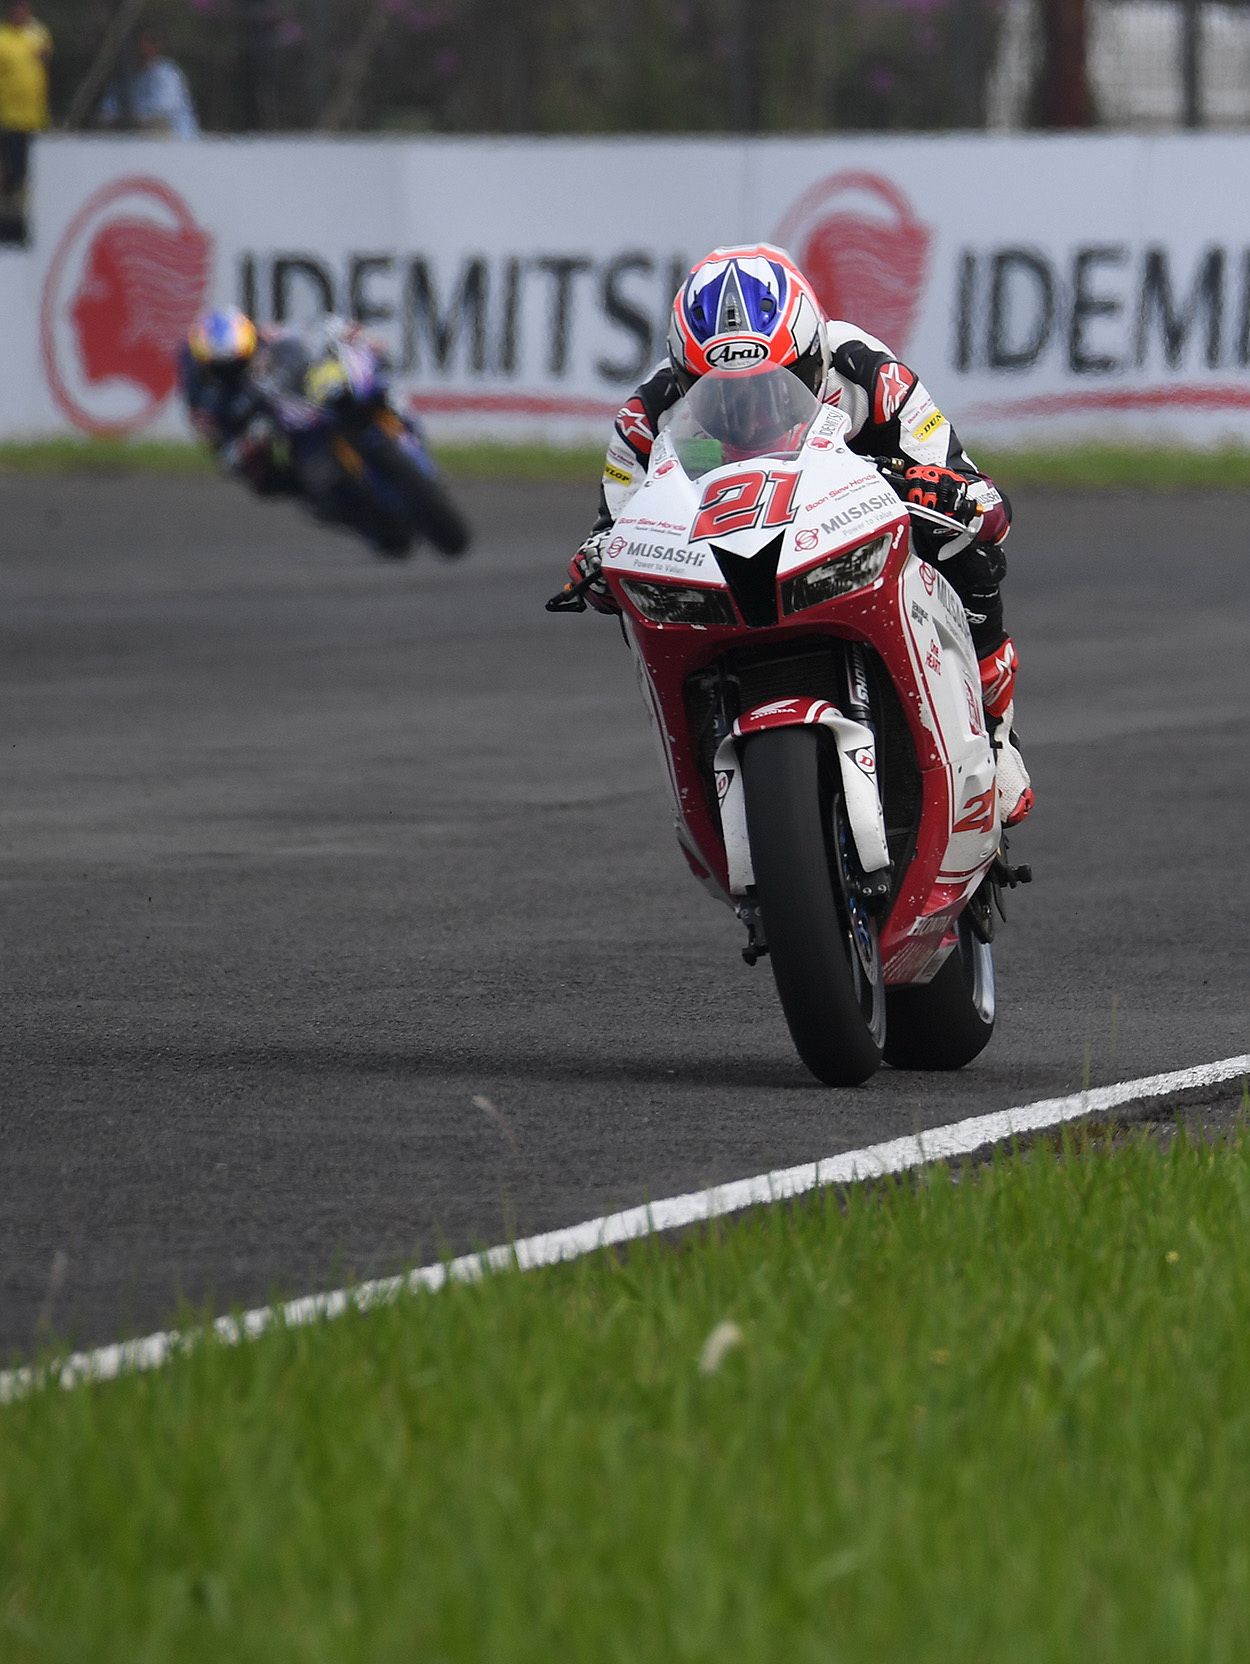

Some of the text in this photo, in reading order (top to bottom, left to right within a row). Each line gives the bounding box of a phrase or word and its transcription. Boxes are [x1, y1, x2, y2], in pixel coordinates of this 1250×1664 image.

[238, 250, 692, 386] IDEMITS
[711, 344, 761, 364] Arai
[688, 469, 802, 544] 21
[805, 497, 829, 512] Boon
[828, 485, 850, 498] Siew
[849, 473, 877, 488] Honda
[952, 776, 995, 834] 21
